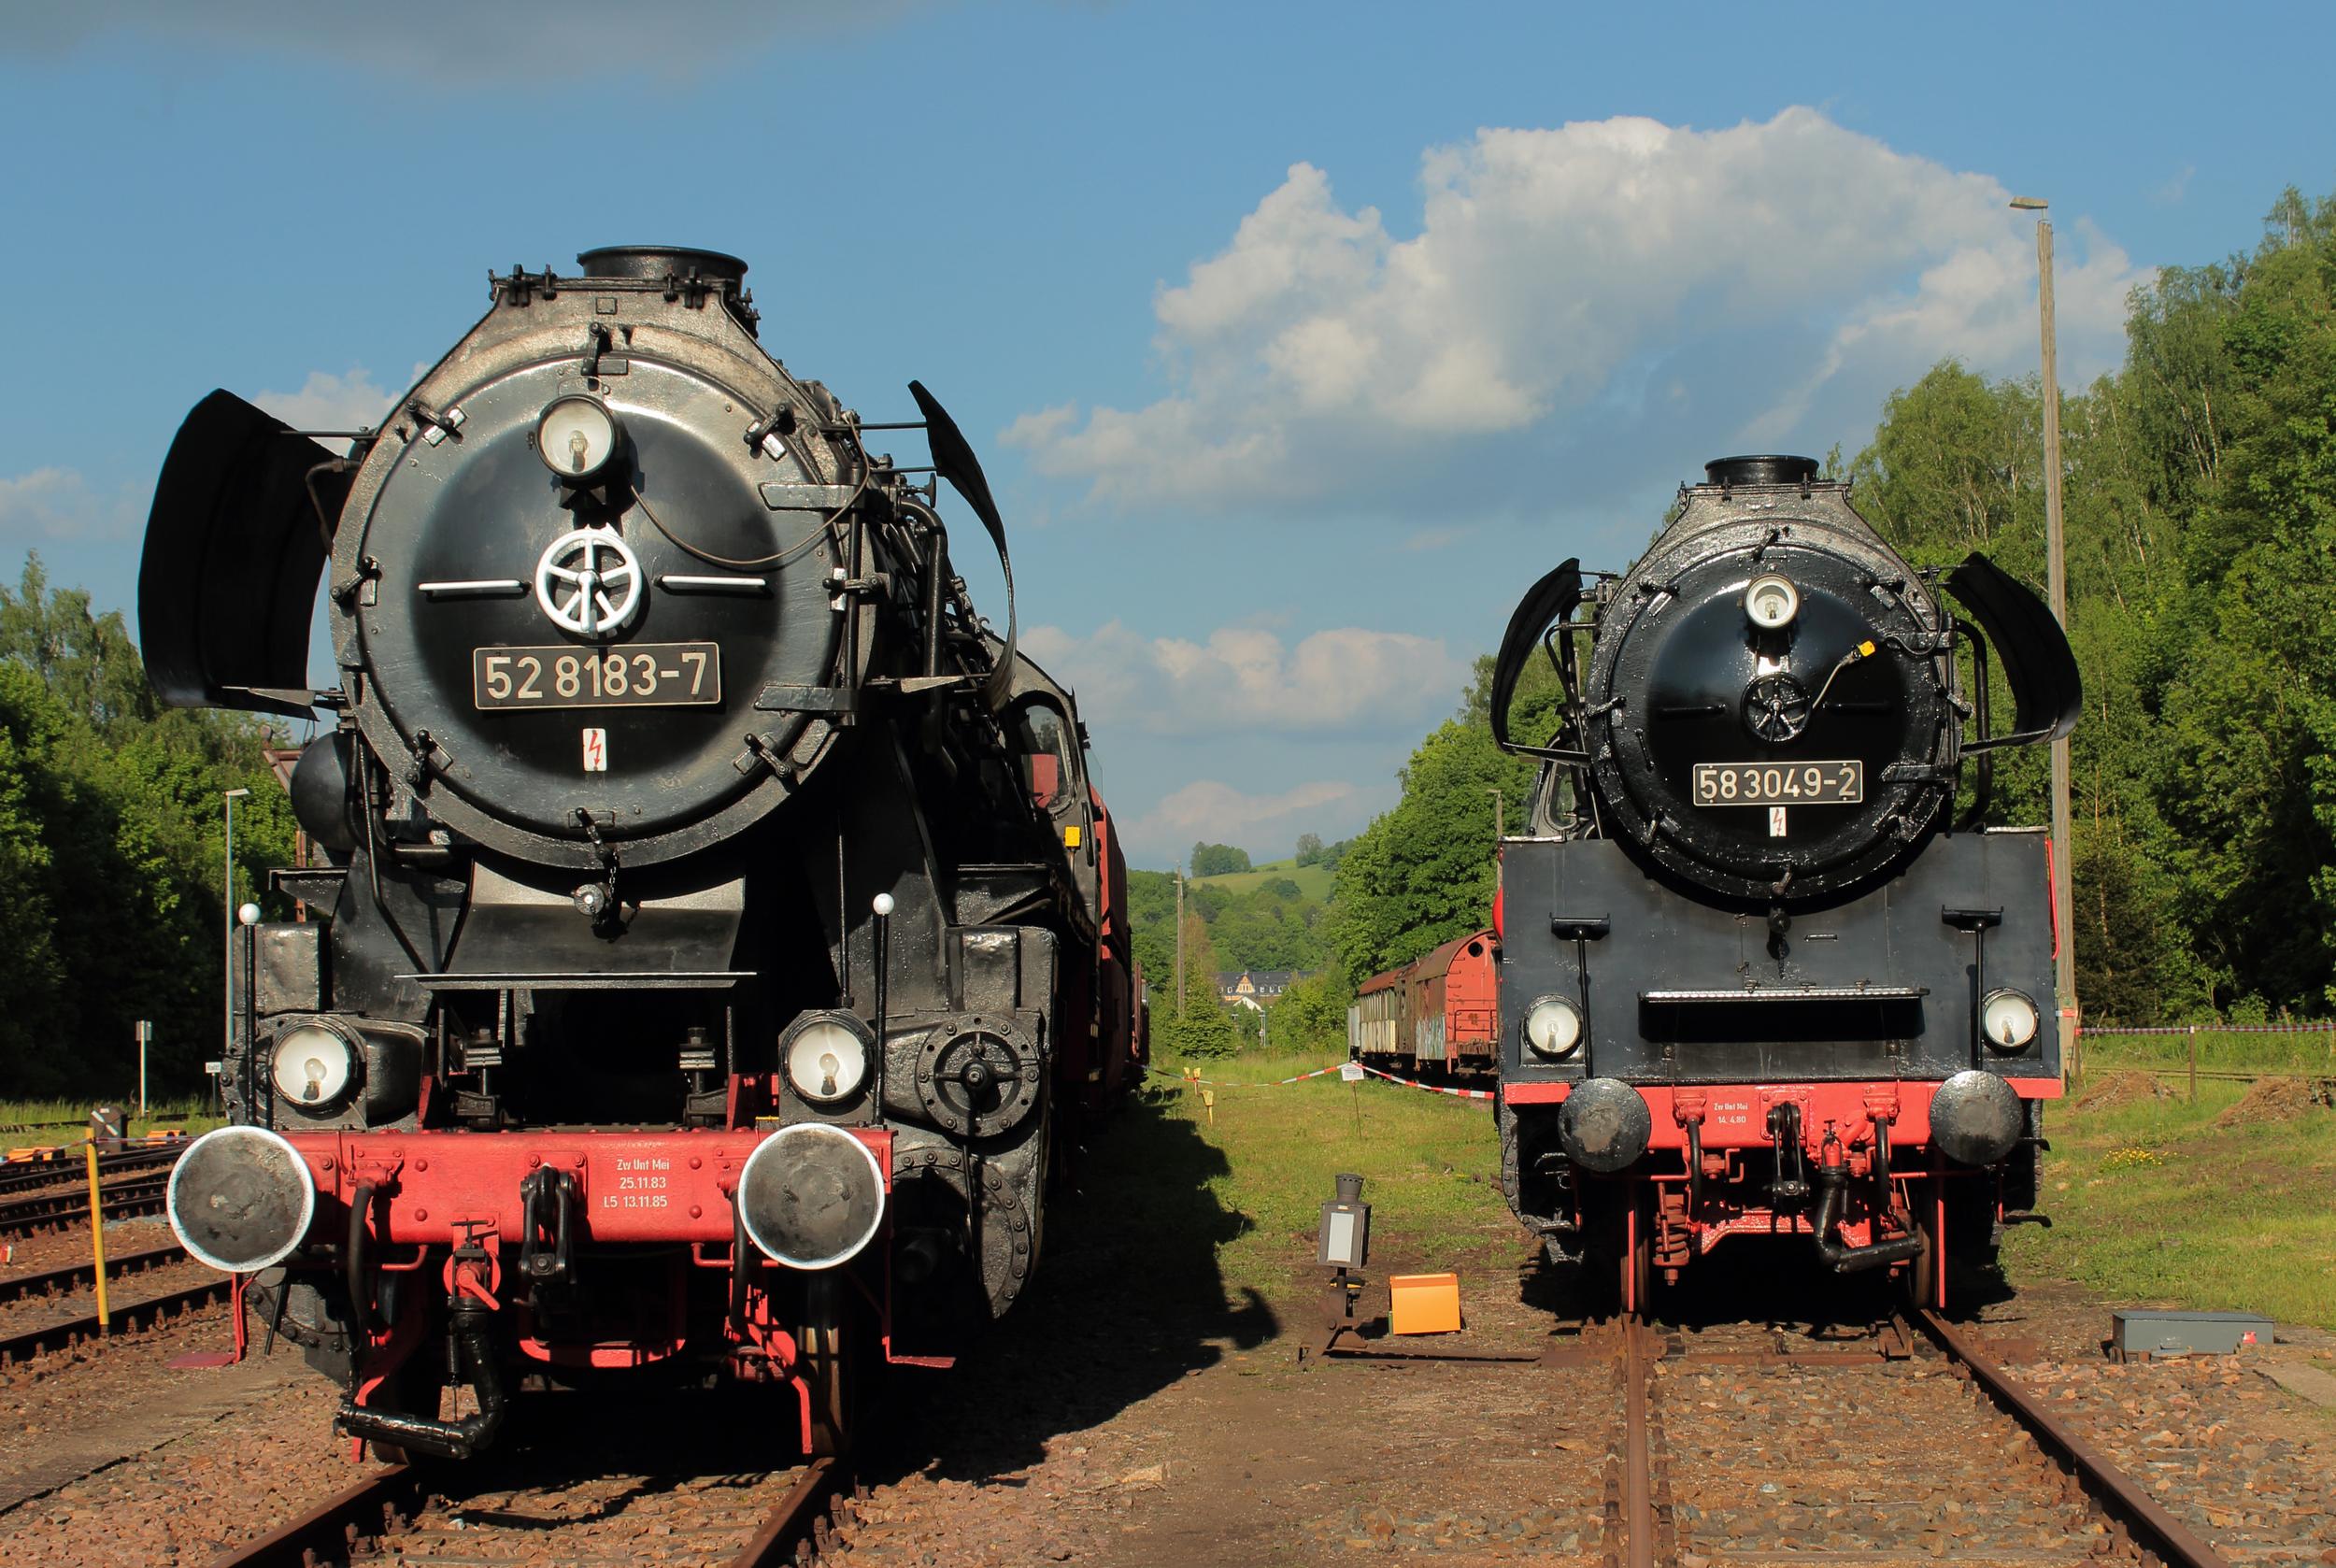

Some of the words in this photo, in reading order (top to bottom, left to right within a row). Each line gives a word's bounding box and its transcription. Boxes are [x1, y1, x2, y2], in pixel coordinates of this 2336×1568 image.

[486, 656, 543, 700] 52
[555, 652, 707, 697] 8183-7
[1700, 769, 1738, 800] 58
[1743, 766, 1857, 799] 3049-2
[617, 1159, 632, 1171] Zw
[634, 1159, 649, 1171] Unt
[652, 1158, 670, 1171] Mei
[620, 1176, 666, 1190] 25.11.83
[604, 1196, 619, 1208] L5
[623, 1195, 668, 1208] 13.11.85
